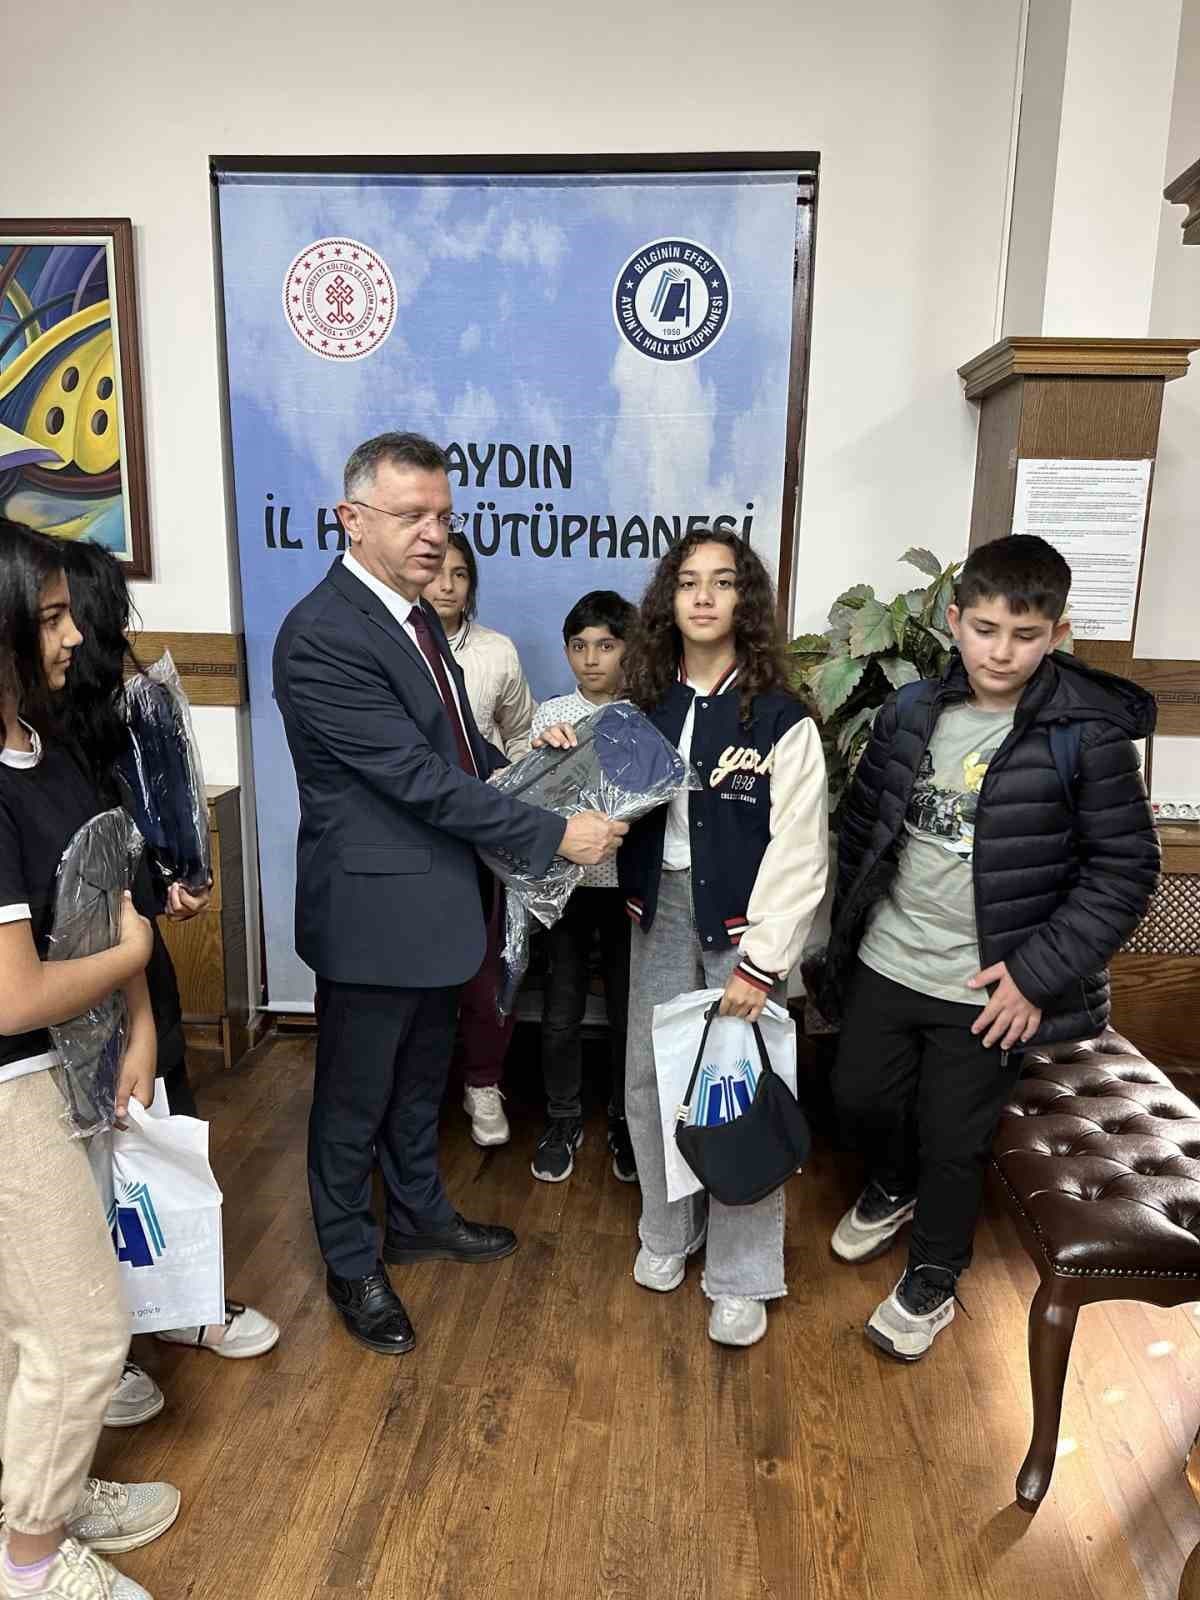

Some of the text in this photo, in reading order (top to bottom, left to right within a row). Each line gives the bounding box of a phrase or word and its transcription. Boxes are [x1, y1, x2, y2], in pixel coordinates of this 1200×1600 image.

[634, 245, 714, 274] BİLGİNİN EFESİ
[621, 295, 638, 330] AYDIN
[642, 336, 670, 355] HALK
[672, 295, 723, 355] KÜTÜPHANESİ
[444, 442, 572, 489] AYDIN
[265, 493, 303, 549] İL
[452, 502, 754, 559] ÜTÜPHANİ
